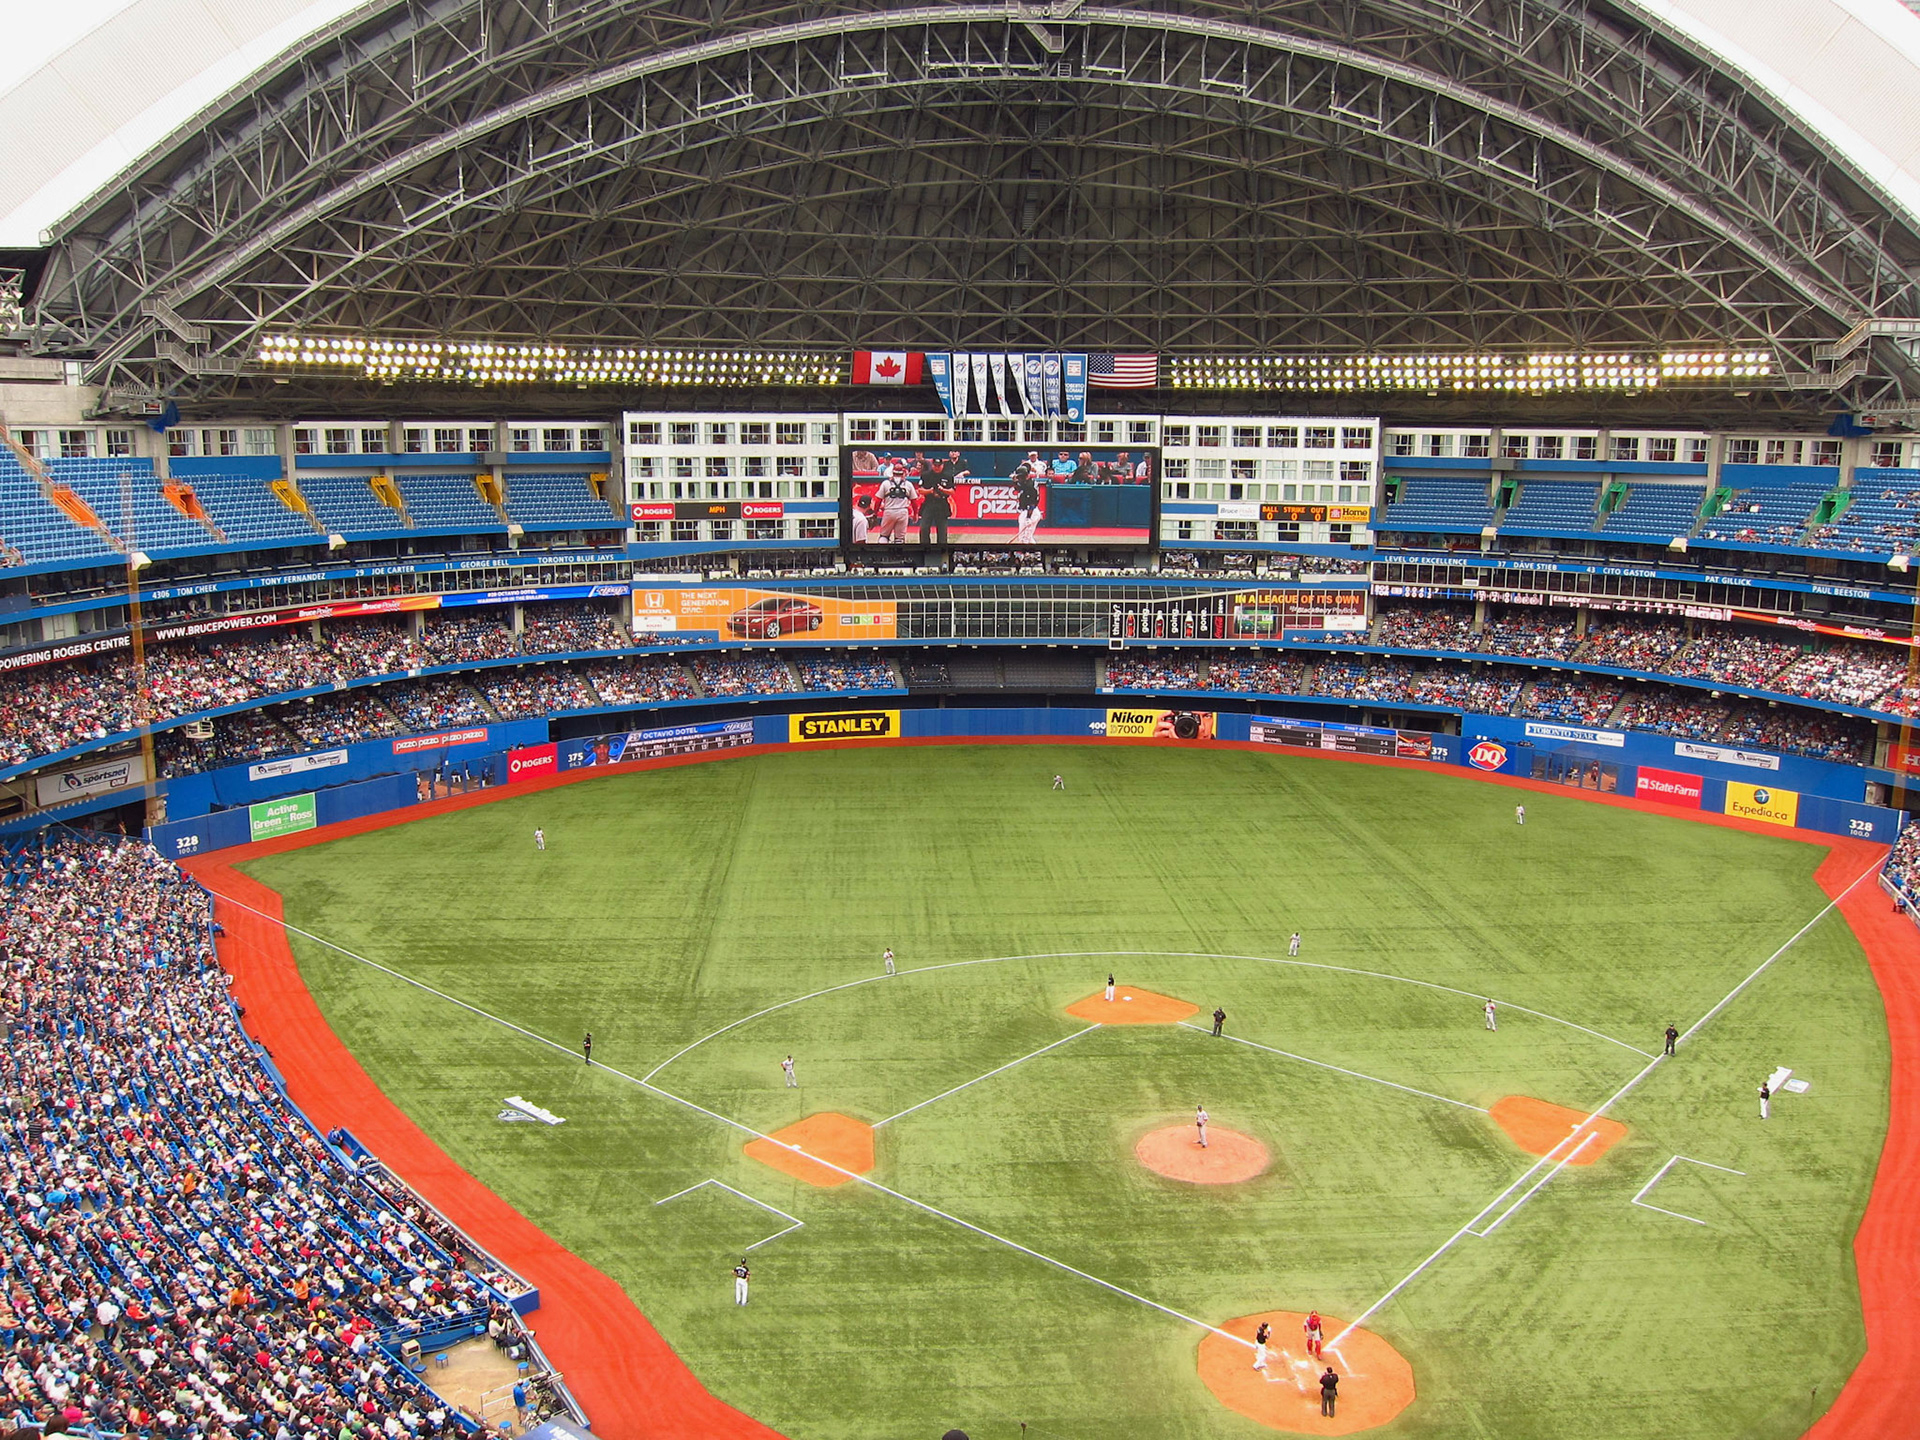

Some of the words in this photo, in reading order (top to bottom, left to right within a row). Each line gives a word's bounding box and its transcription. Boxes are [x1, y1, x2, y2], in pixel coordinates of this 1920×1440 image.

[1028, 377, 1041, 387] 1992
[1046, 377, 1060, 387] 1993
[978, 500, 1021, 518] pizz
[1342, 508, 1368, 516] Home
[1291, 513, 1298, 521] 0
[445, 562, 454, 570] 11
[460, 560, 489, 569] GEORGE
[490, 558, 510, 567] BELL
[538, 556, 574, 565] TORONTO
[576, 555, 596, 563] BLUE
[598, 554, 615, 562] JAYS
[1421, 557, 1468, 566] EXCELLENCE
[355, 569, 365, 577] 29
[371, 567, 385, 576] JOE
[386, 565, 416, 575] CARTER
[1513, 561, 1535, 570] DAVE
[1536, 563, 1558, 571] STIEB
[1586, 566, 1596, 574] 43
[1603, 567, 1621, 575] CITO
[1623, 568, 1657, 578] GASTON
[261, 577, 281, 586] TONY
[283, 572, 326, 583] FERNANDEZ
[1705, 576, 1720, 584] PAT
[1721, 577, 1752, 586] GILLICK
[152, 590, 171, 599] 4306
[177, 588, 194, 597] TOM
[195, 584, 218, 595] CHEEK
[1812, 585, 1832, 595] PAUL
[1833, 587, 1871, 599] BEESTON
[681, 599, 730, 607] GENERATION
[1235, 595, 1247, 604] IN
[1248, 595, 1256, 604] A
[1259, 595, 1298, 604] LEAGUE
[1301, 595, 1314, 604] OF
[1317, 595, 1335, 604] ITS
[1336, 595, 1360, 604] OWN
[1564, 596, 1591, 604] LACKEY
[1911, 596, 1920, 604] 12
[361, 602, 382, 611] Bruce
[1298, 606, 1332, 614] BlackBerry
[298, 609, 317, 618] Bruce
[1112, 604, 1122, 636] thirsty?
[1200, 607, 1208, 632] gone.
[1777, 617, 1797, 626] Bruce
[156, 614, 277, 640] WWW.BRUCEPOWER.COM
[1844, 625, 1865, 634] Bruce
[0, 650, 51, 670] POWERING
[53, 642, 93, 660] ROGERS
[94, 635, 131, 652] CENTRE
[1111, 712, 1154, 724] Nikon
[805, 717, 885, 735] STANLEY
[1088, 721, 1106, 730] 400
[1110, 724, 1144, 734] D7000
[643, 730, 674, 740] OCTAVIO
[675, 727, 698, 736] DOTEL
[1532, 726, 1572, 738] TORONTO
[1572, 731, 1595, 741] STAR
[396, 740, 417, 752] pizza
[418, 737, 439, 748] pizza
[441, 733, 462, 744] pizza
[462, 730, 485, 741] pizza
[1398, 740, 1414, 748] Bruce
[1431, 746, 1448, 756] 375
[1475, 747, 1502, 765] DQ
[522, 756, 554, 769] ROGERS
[567, 752, 584, 763] 375
[83, 767, 127, 785] sportsnet
[266, 803, 299, 818] Active
[1732, 801, 1788, 821] Expedia.ca
[253, 816, 282, 831] Green
[289, 809, 313, 823] Ross
[1848, 819, 1873, 832] 328
[1850, 829, 1870, 838] 100.0
[176, 835, 199, 849] 328
[178, 846, 198, 855] 100.0
